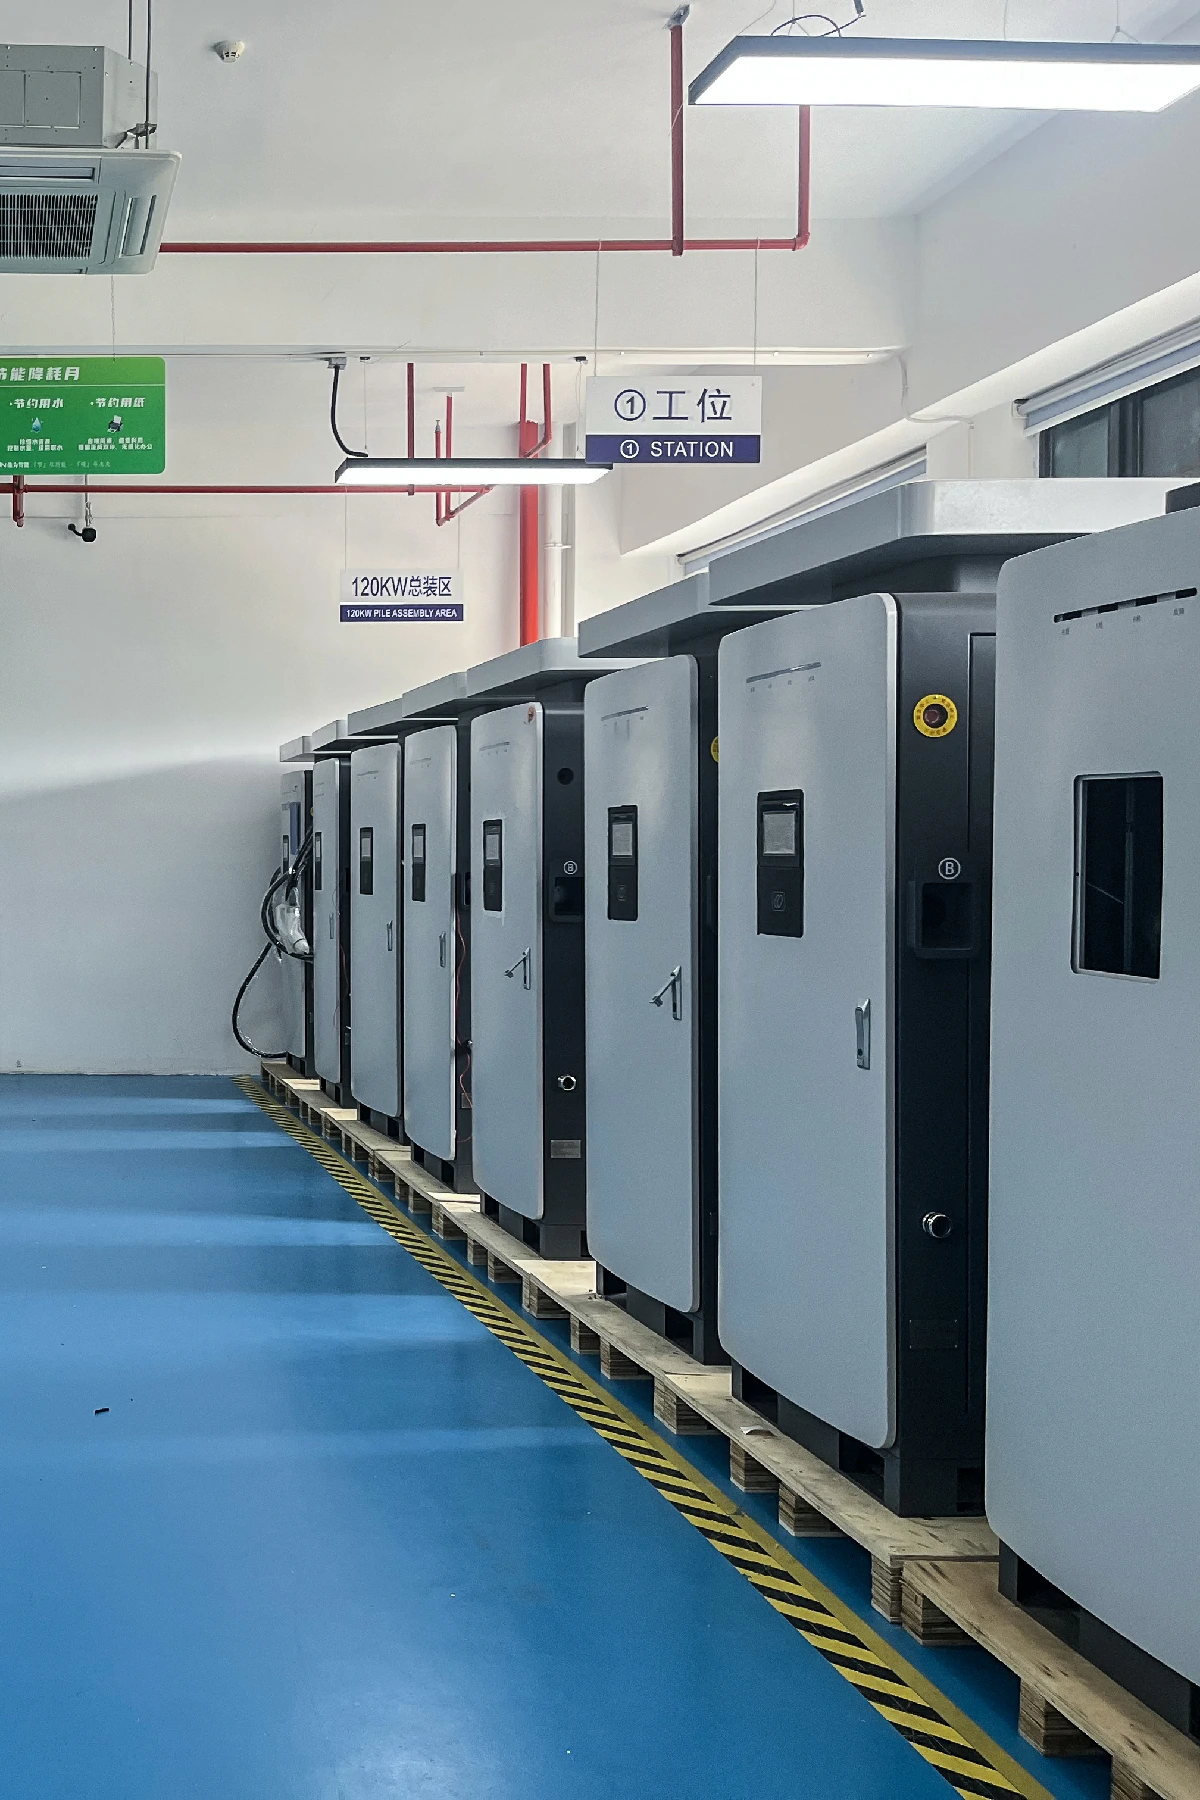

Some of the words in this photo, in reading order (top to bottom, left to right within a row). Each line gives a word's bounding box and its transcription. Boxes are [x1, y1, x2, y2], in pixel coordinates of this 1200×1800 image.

[13, 398, 64, 409] 节约用水
[650, 441, 733, 458] STATION
[352, 576, 452, 597] 120KW总装区
[346, 609, 372, 618] 120KW
[373, 609, 391, 618] PILE
[392, 608, 434, 618] ASSEMBLY
[434, 608, 458, 618] AREA
